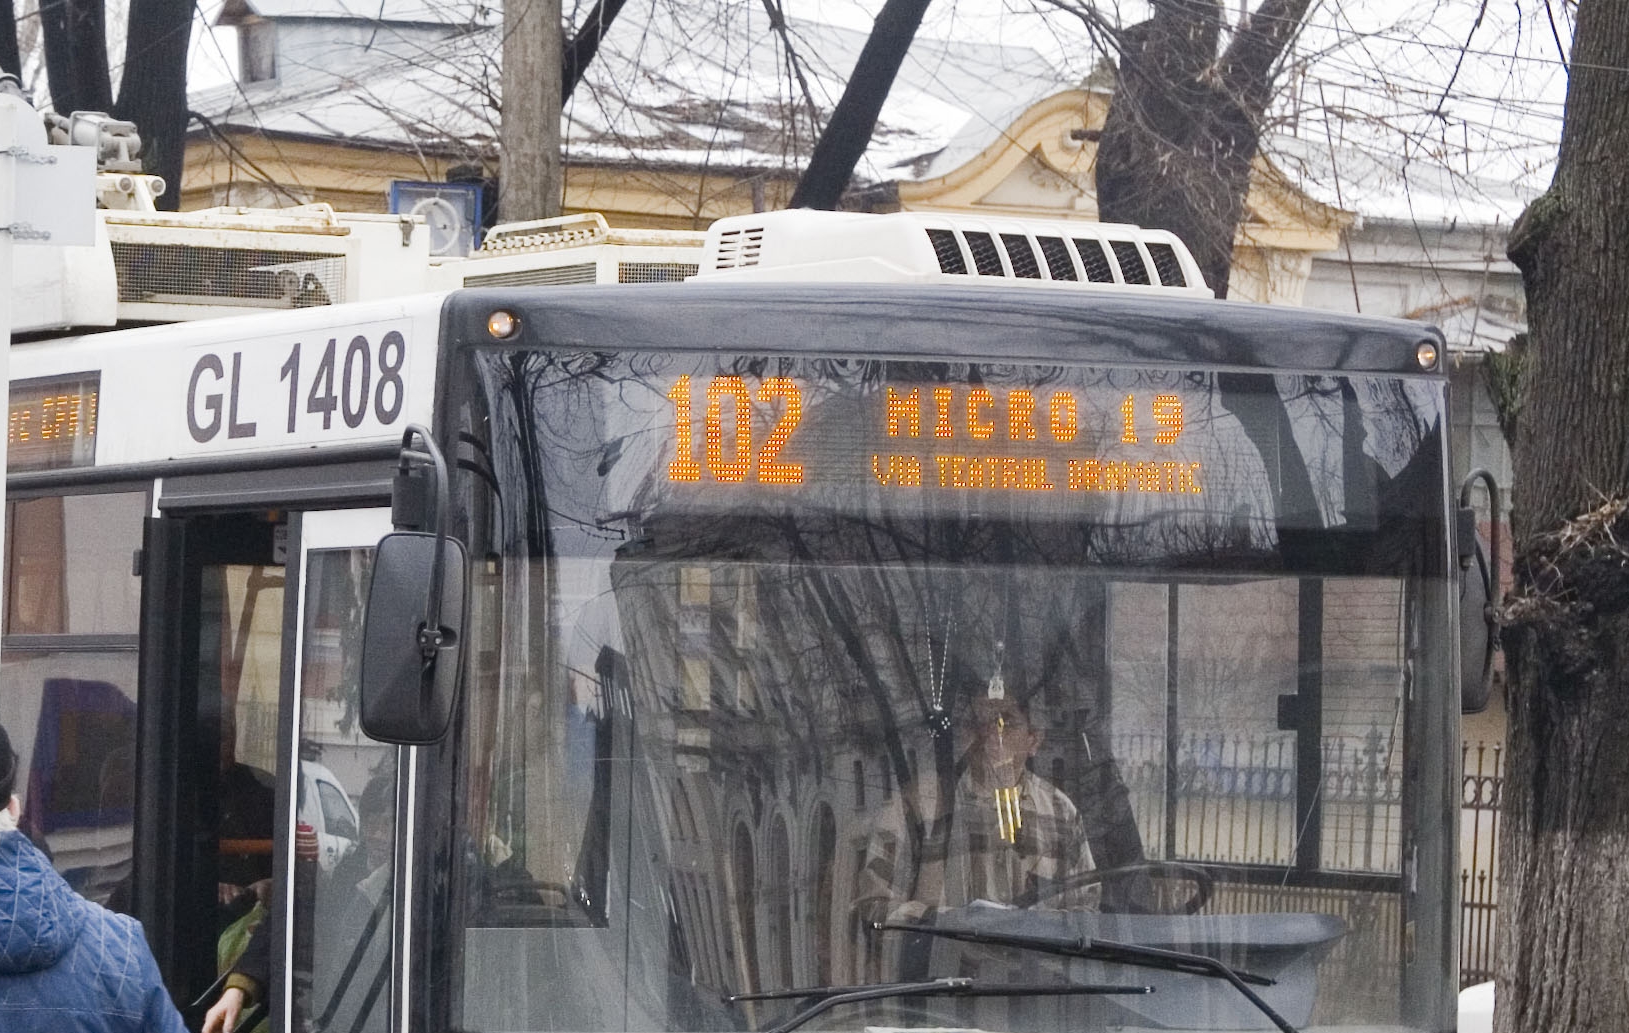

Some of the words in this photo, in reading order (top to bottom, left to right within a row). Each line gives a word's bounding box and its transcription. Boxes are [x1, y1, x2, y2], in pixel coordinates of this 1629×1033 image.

[186, 351, 257, 443] GL
[280, 331, 406, 434] 1408
[667, 373, 804, 484] 102
[887, 387, 1077, 441] MICRO
[1120, 394, 1183, 445] 19
[872, 455, 922, 487] VIA
[934, 457, 1055, 490] TEATRUL
[1068, 459, 1202, 494] DRAMATIC
